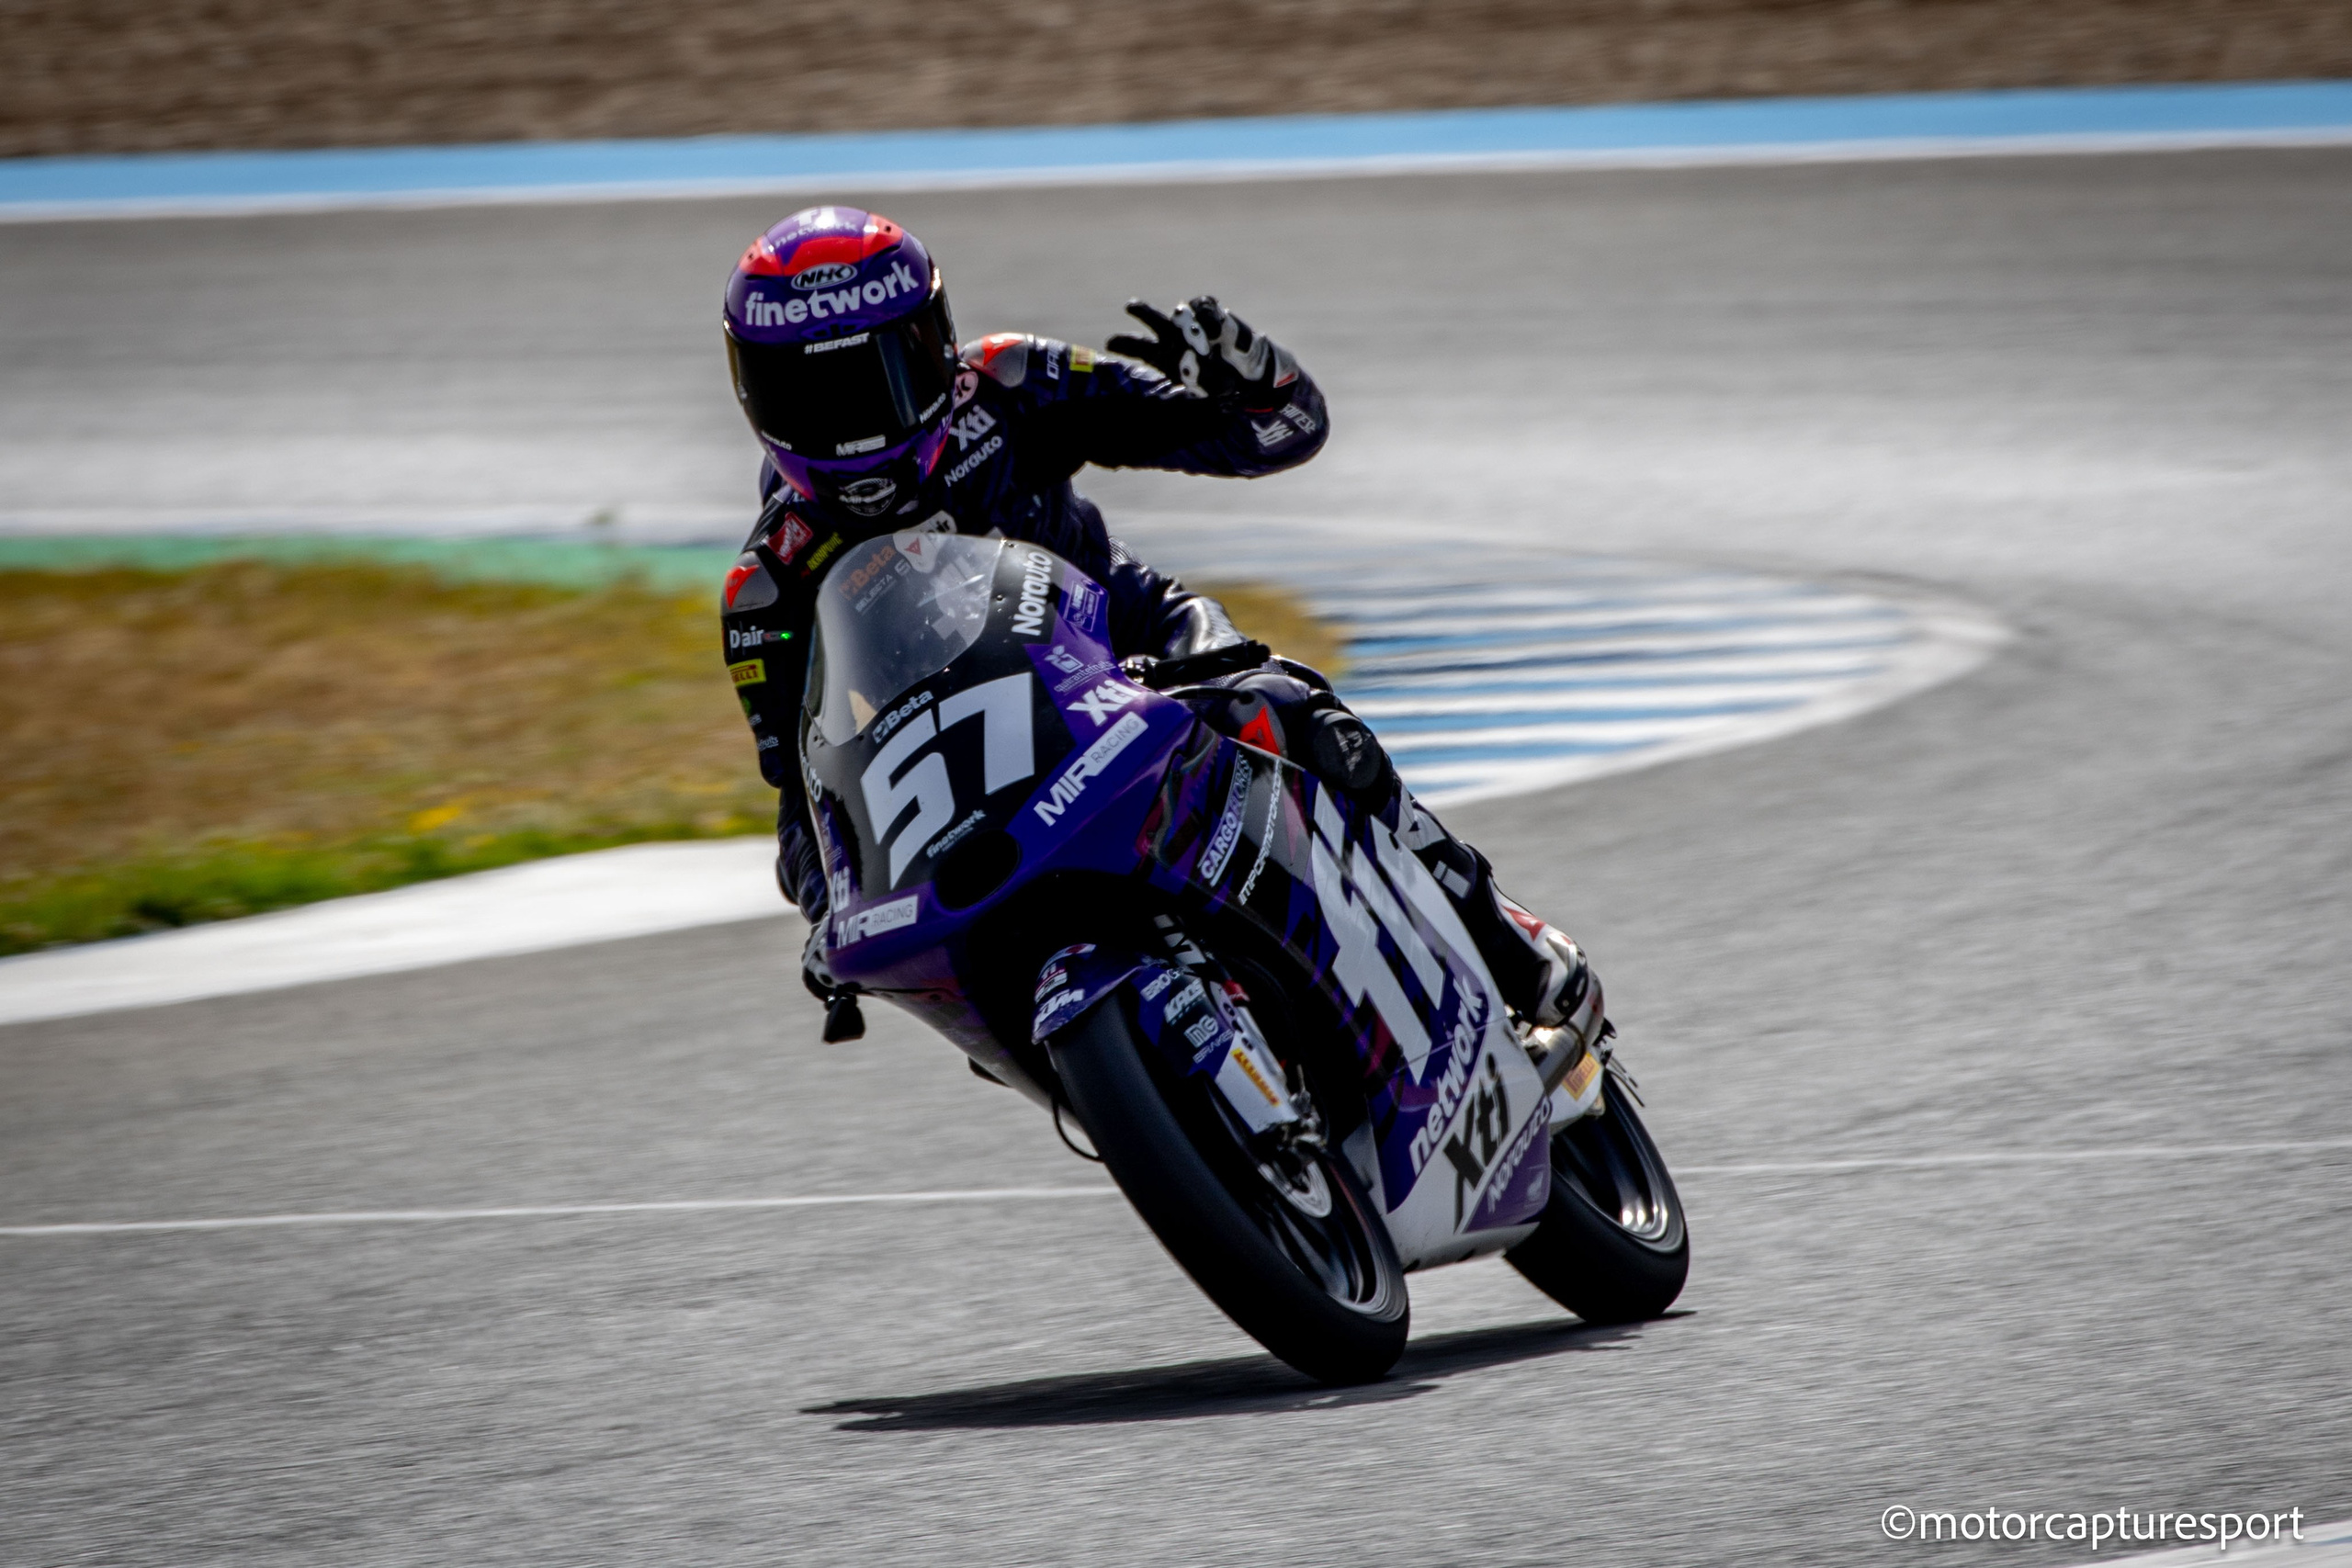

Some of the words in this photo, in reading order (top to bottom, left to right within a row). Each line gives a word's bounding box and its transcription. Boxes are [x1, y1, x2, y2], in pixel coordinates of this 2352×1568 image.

[745, 261, 919, 326] finetwork
[797, 265, 848, 287] NHK
[804, 333, 870, 354] #BEFAST
[950, 404, 997, 451] Xti
[944, 434, 1003, 487] Norauto
[1012, 551, 1053, 637] Norauto
[885, 690, 933, 733] Beta
[1066, 679, 1143, 727] Xti
[861, 671, 1035, 891] 57
[1033, 759, 1094, 827] MIR
[1090, 717, 1140, 764] RACING
[837, 911, 872, 949] MIR
[871, 902, 914, 928] RACING
[1409, 975, 1486, 1178] network
[1442, 1052, 1511, 1235] Xti
[1487, 1099, 1553, 1213] Norauto
